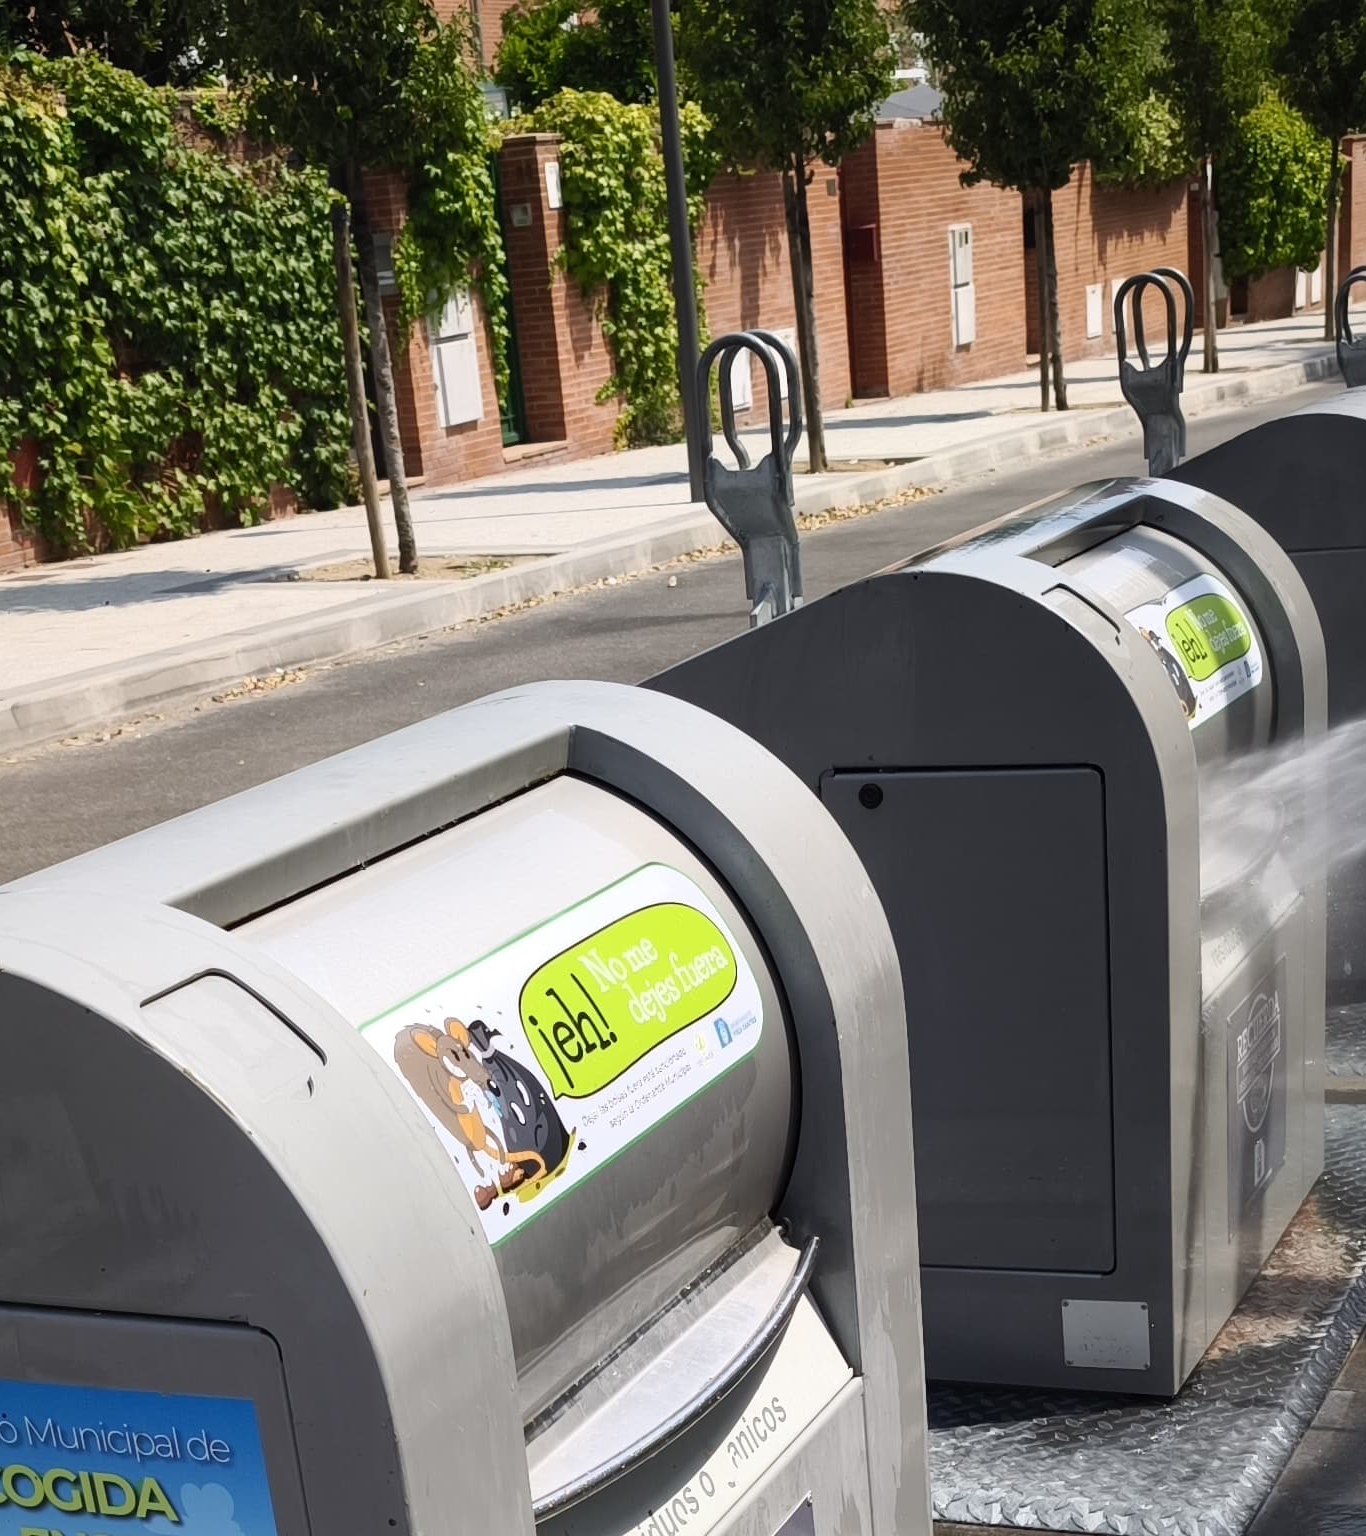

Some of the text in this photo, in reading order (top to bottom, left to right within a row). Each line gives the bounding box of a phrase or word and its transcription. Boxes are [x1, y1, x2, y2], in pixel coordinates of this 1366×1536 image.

[577, 937, 658, 993] No me
[622, 945, 729, 1024] dejes fuera
[24, 1415, 181, 1464] Municipal
[186, 1429, 232, 1464] de
